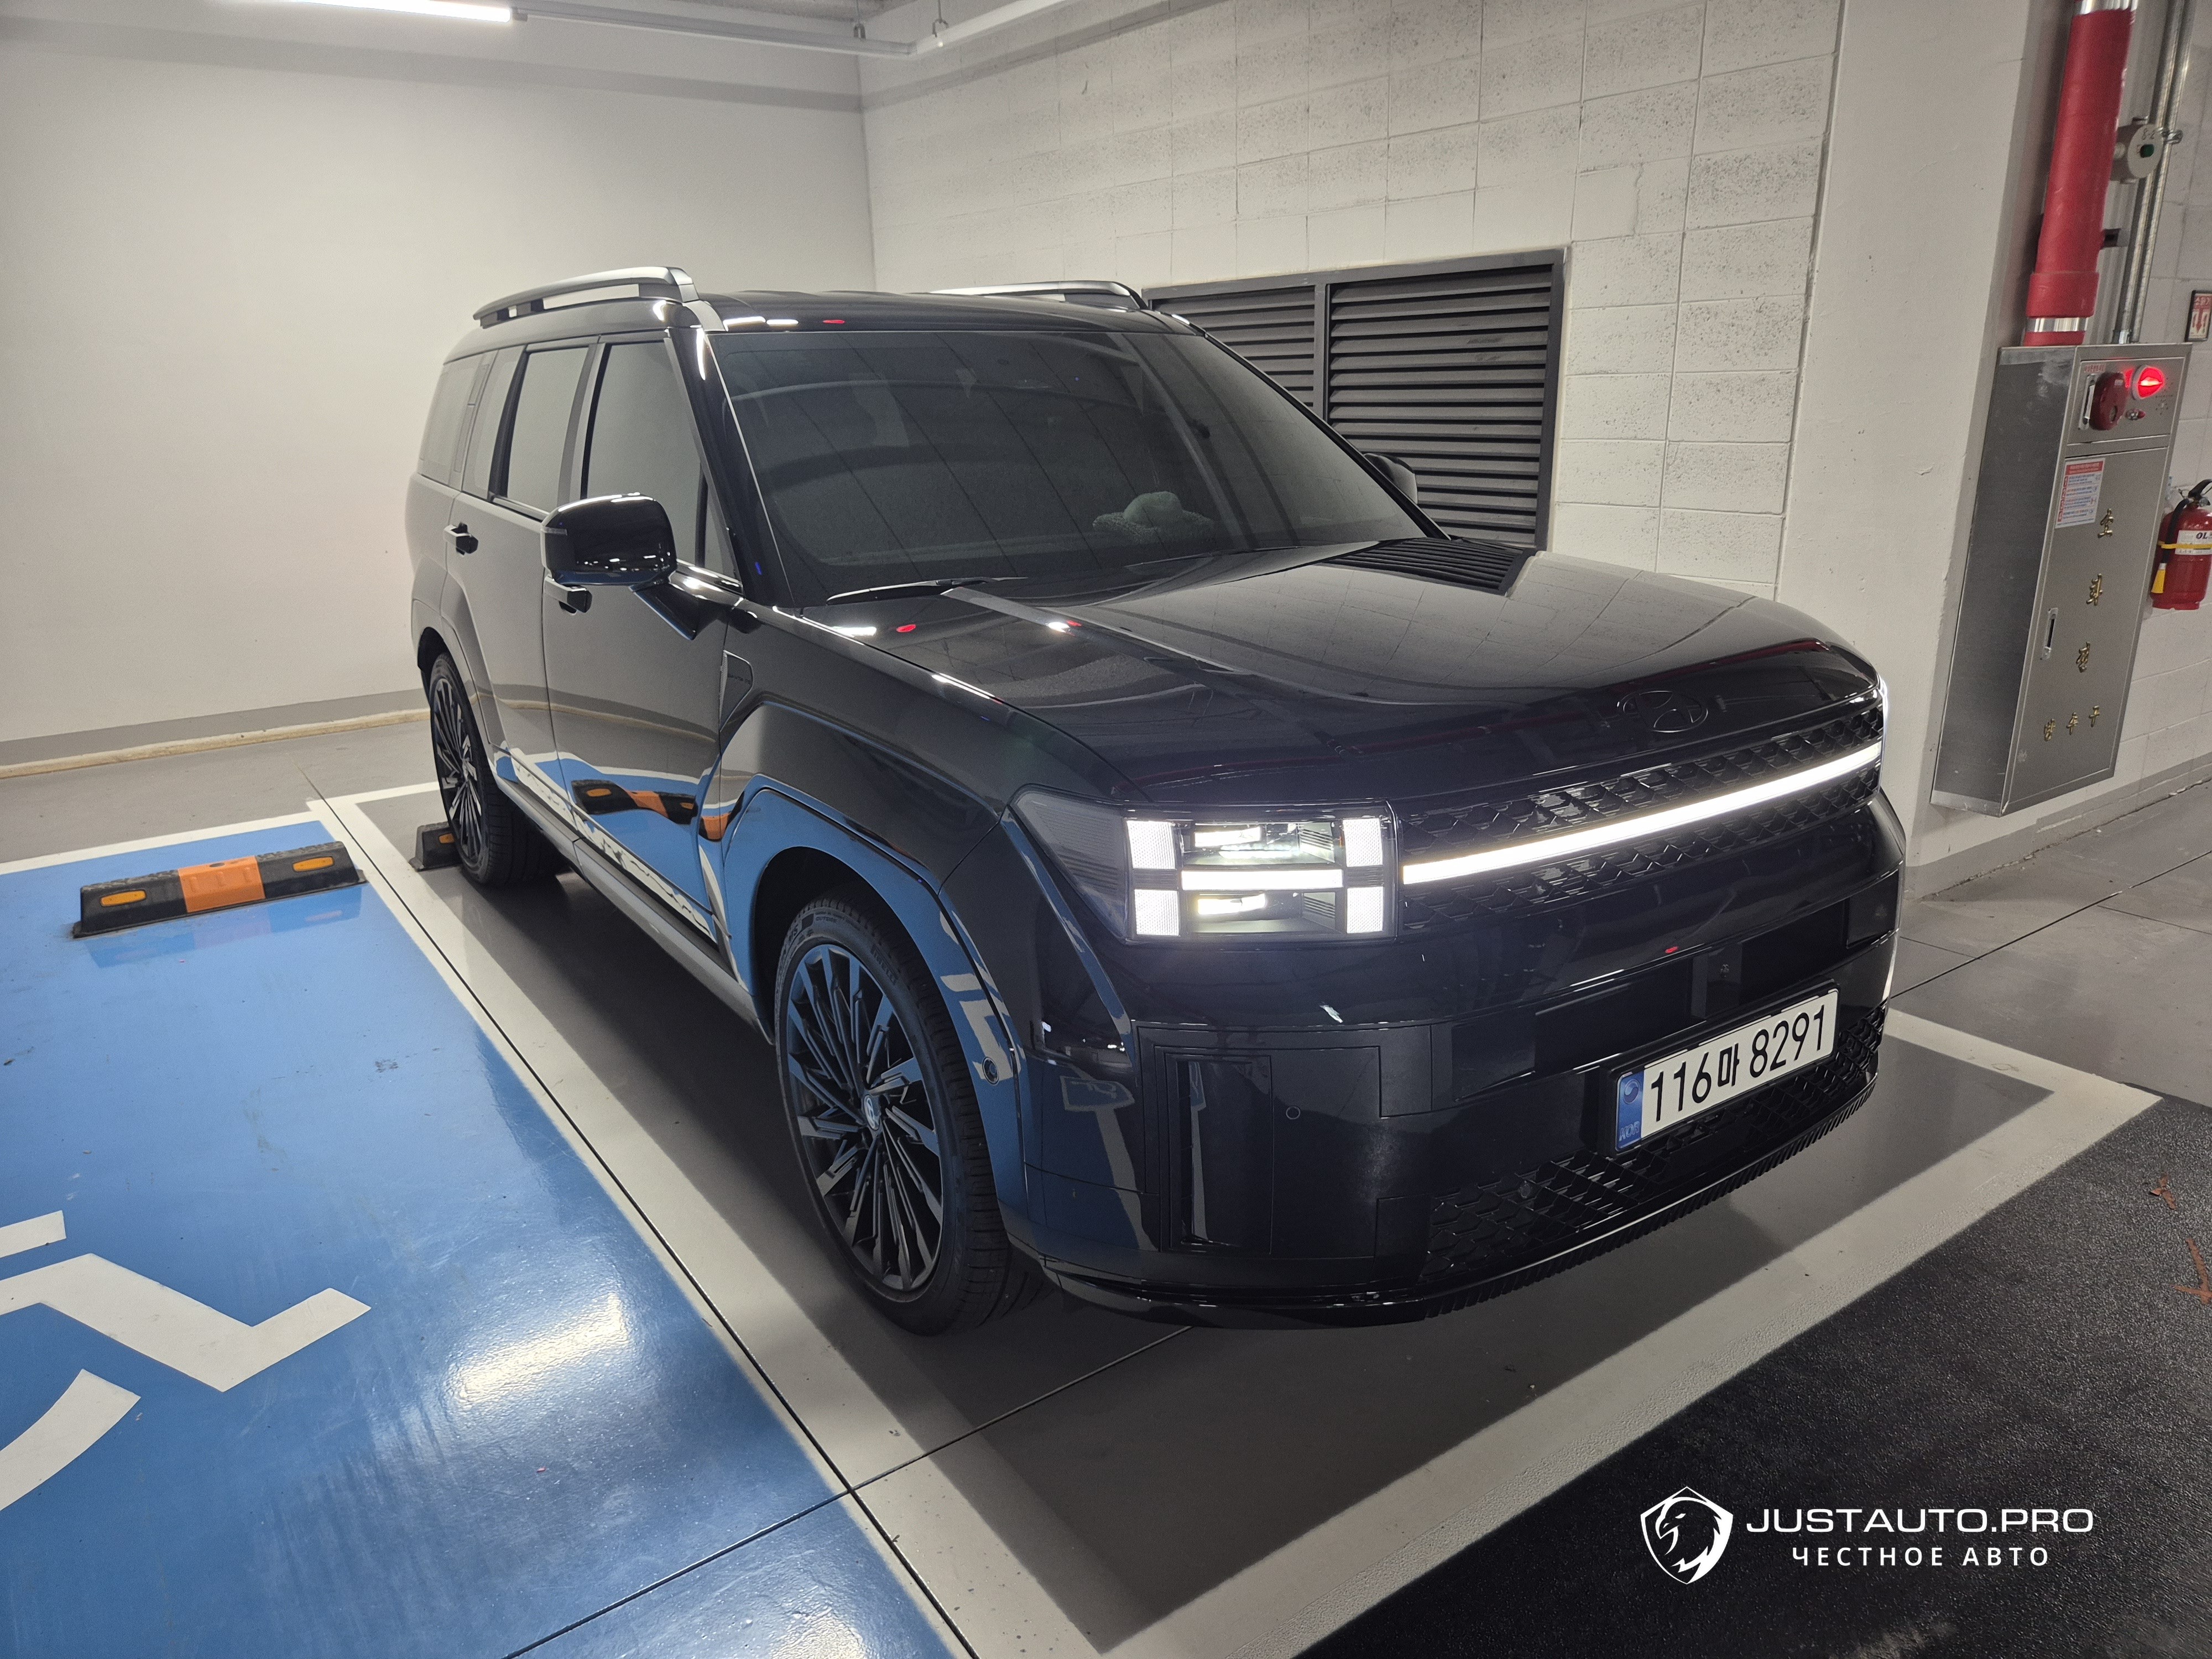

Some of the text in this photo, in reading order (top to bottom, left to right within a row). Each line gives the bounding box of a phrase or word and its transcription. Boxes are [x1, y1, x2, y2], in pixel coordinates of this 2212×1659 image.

[1651, 1005, 1825, 1122] 116마 8291
[1619, 1121, 1640, 1141] KOR
